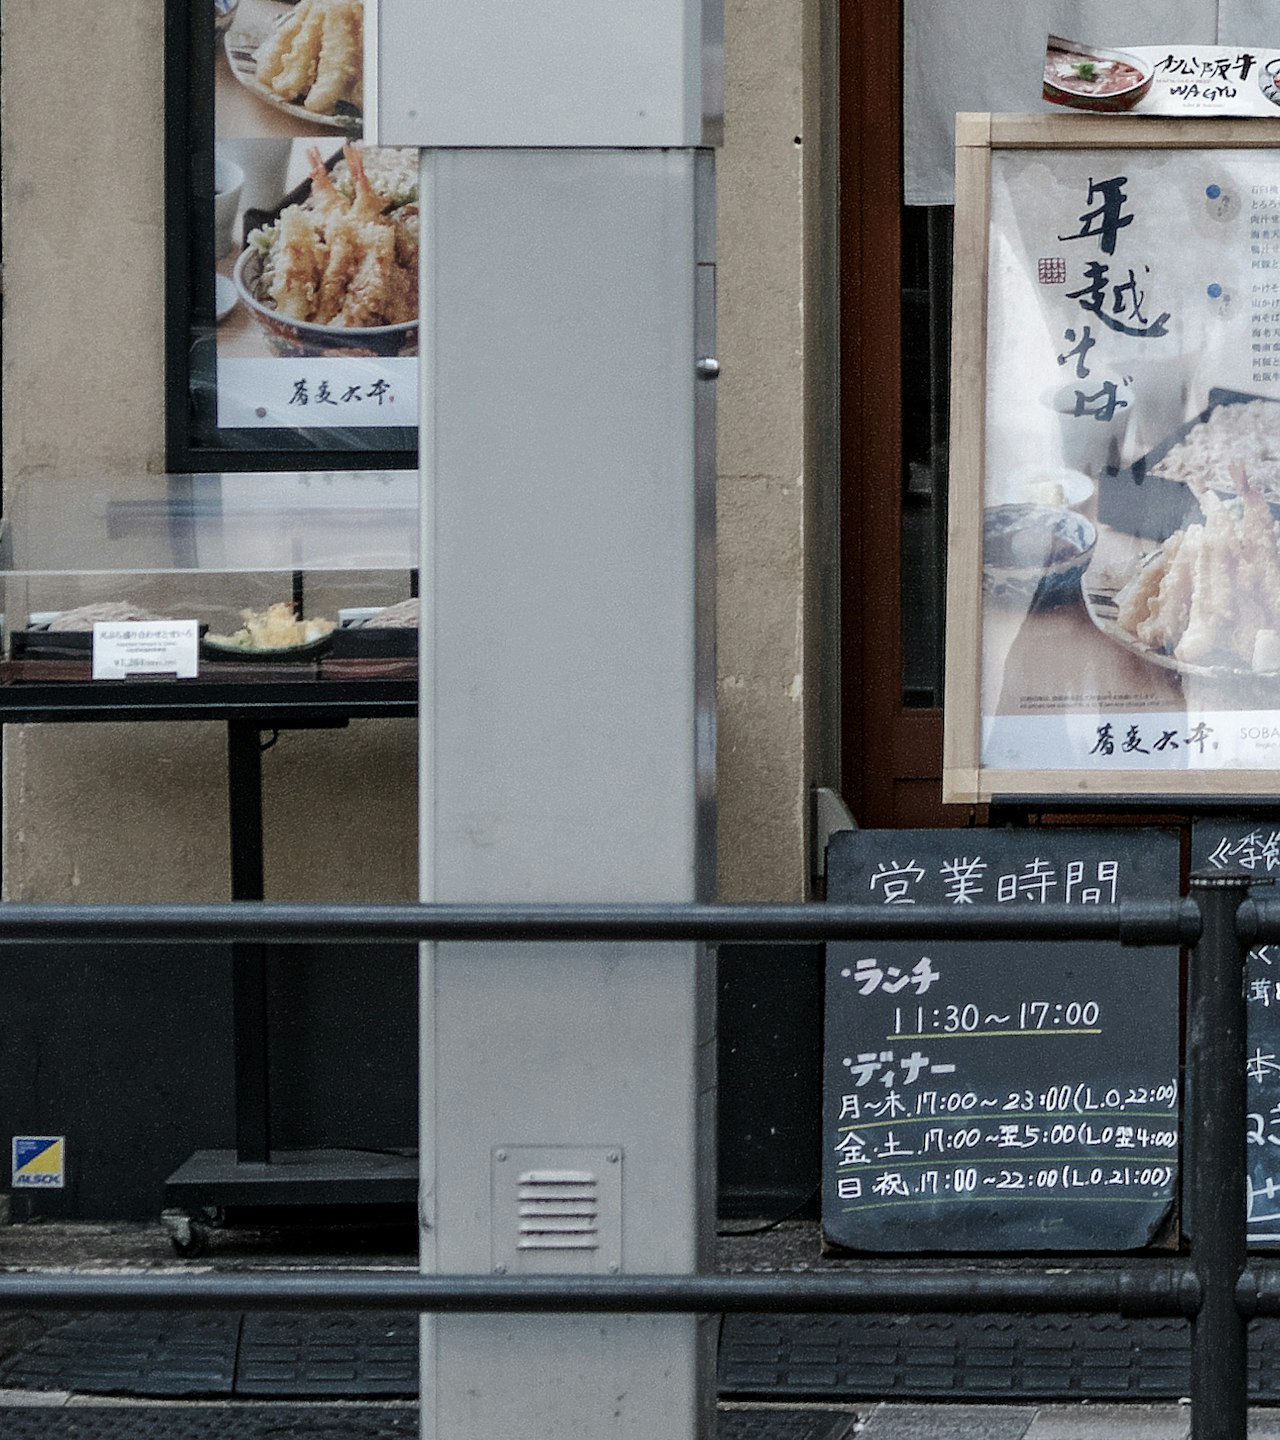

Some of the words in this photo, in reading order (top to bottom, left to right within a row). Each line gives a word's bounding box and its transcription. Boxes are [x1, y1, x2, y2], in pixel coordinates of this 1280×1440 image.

[1169, 83, 1237, 101] WAGYU
[1057, 175, 1171, 422] 年越そば
[869, 856, 1120, 905] 営業時間
[17, 1174, 61, 1184] ALSOK
